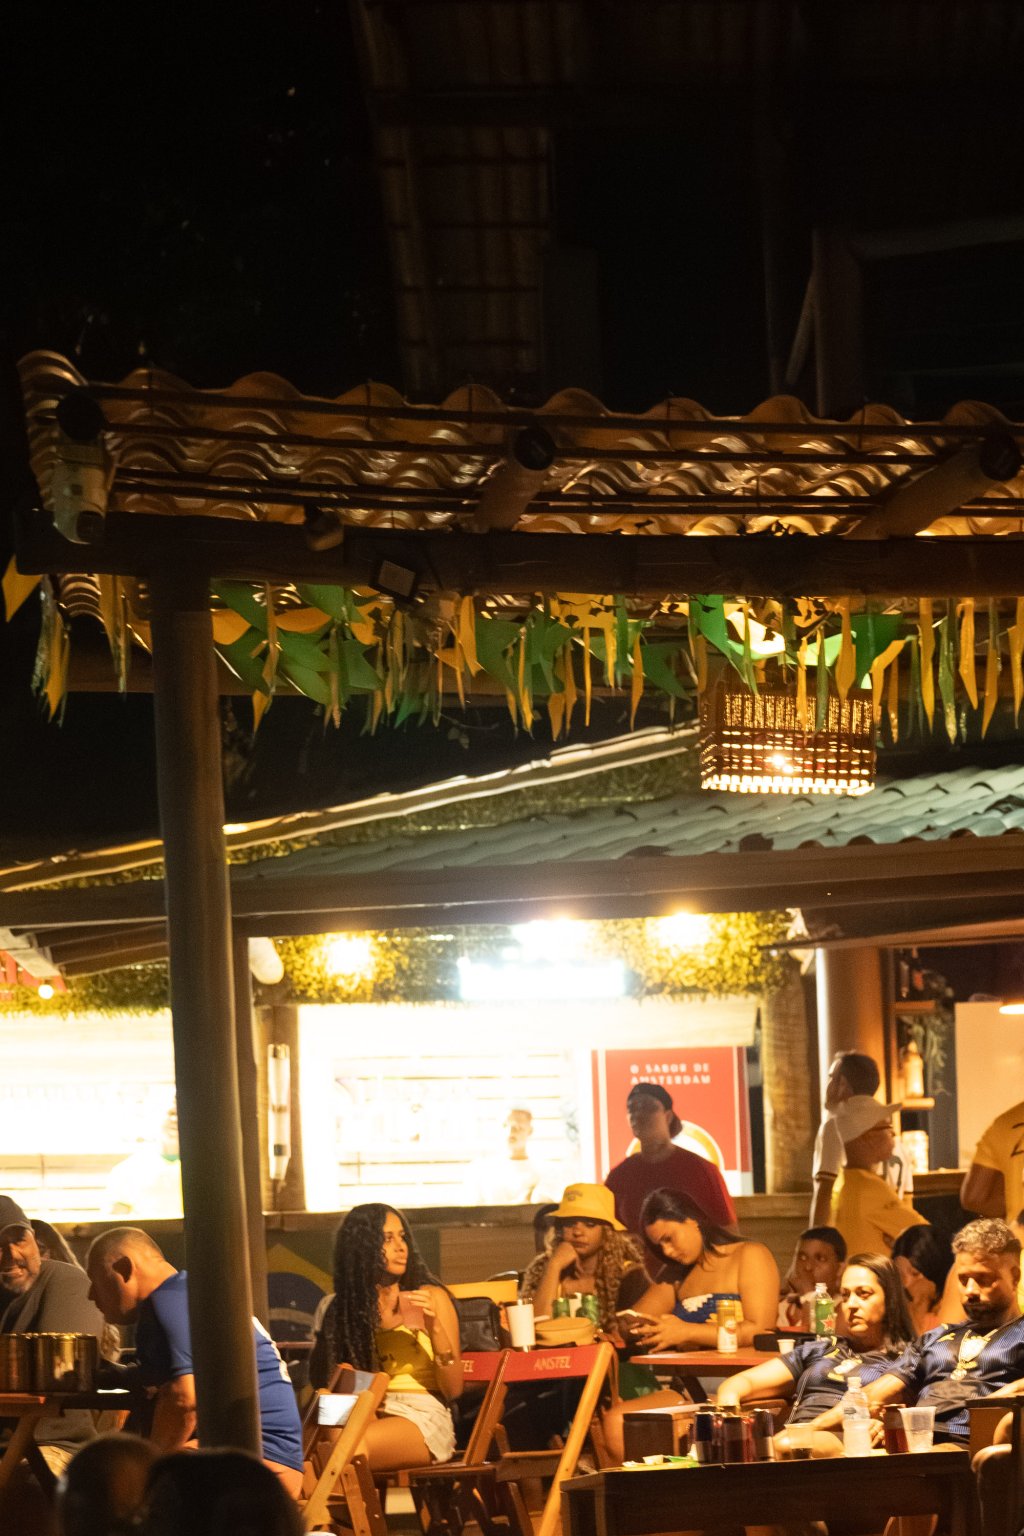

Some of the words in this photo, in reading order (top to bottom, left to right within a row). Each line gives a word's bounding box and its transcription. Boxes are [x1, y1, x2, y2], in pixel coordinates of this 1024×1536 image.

[629, 1063, 639, 1074] O
[645, 1063, 687, 1074] SABOR
[693, 1063, 709, 1073] DE
[630, 1074, 711, 1085] AMSTERDAM
[533, 1356, 572, 1371] AMSTEL
